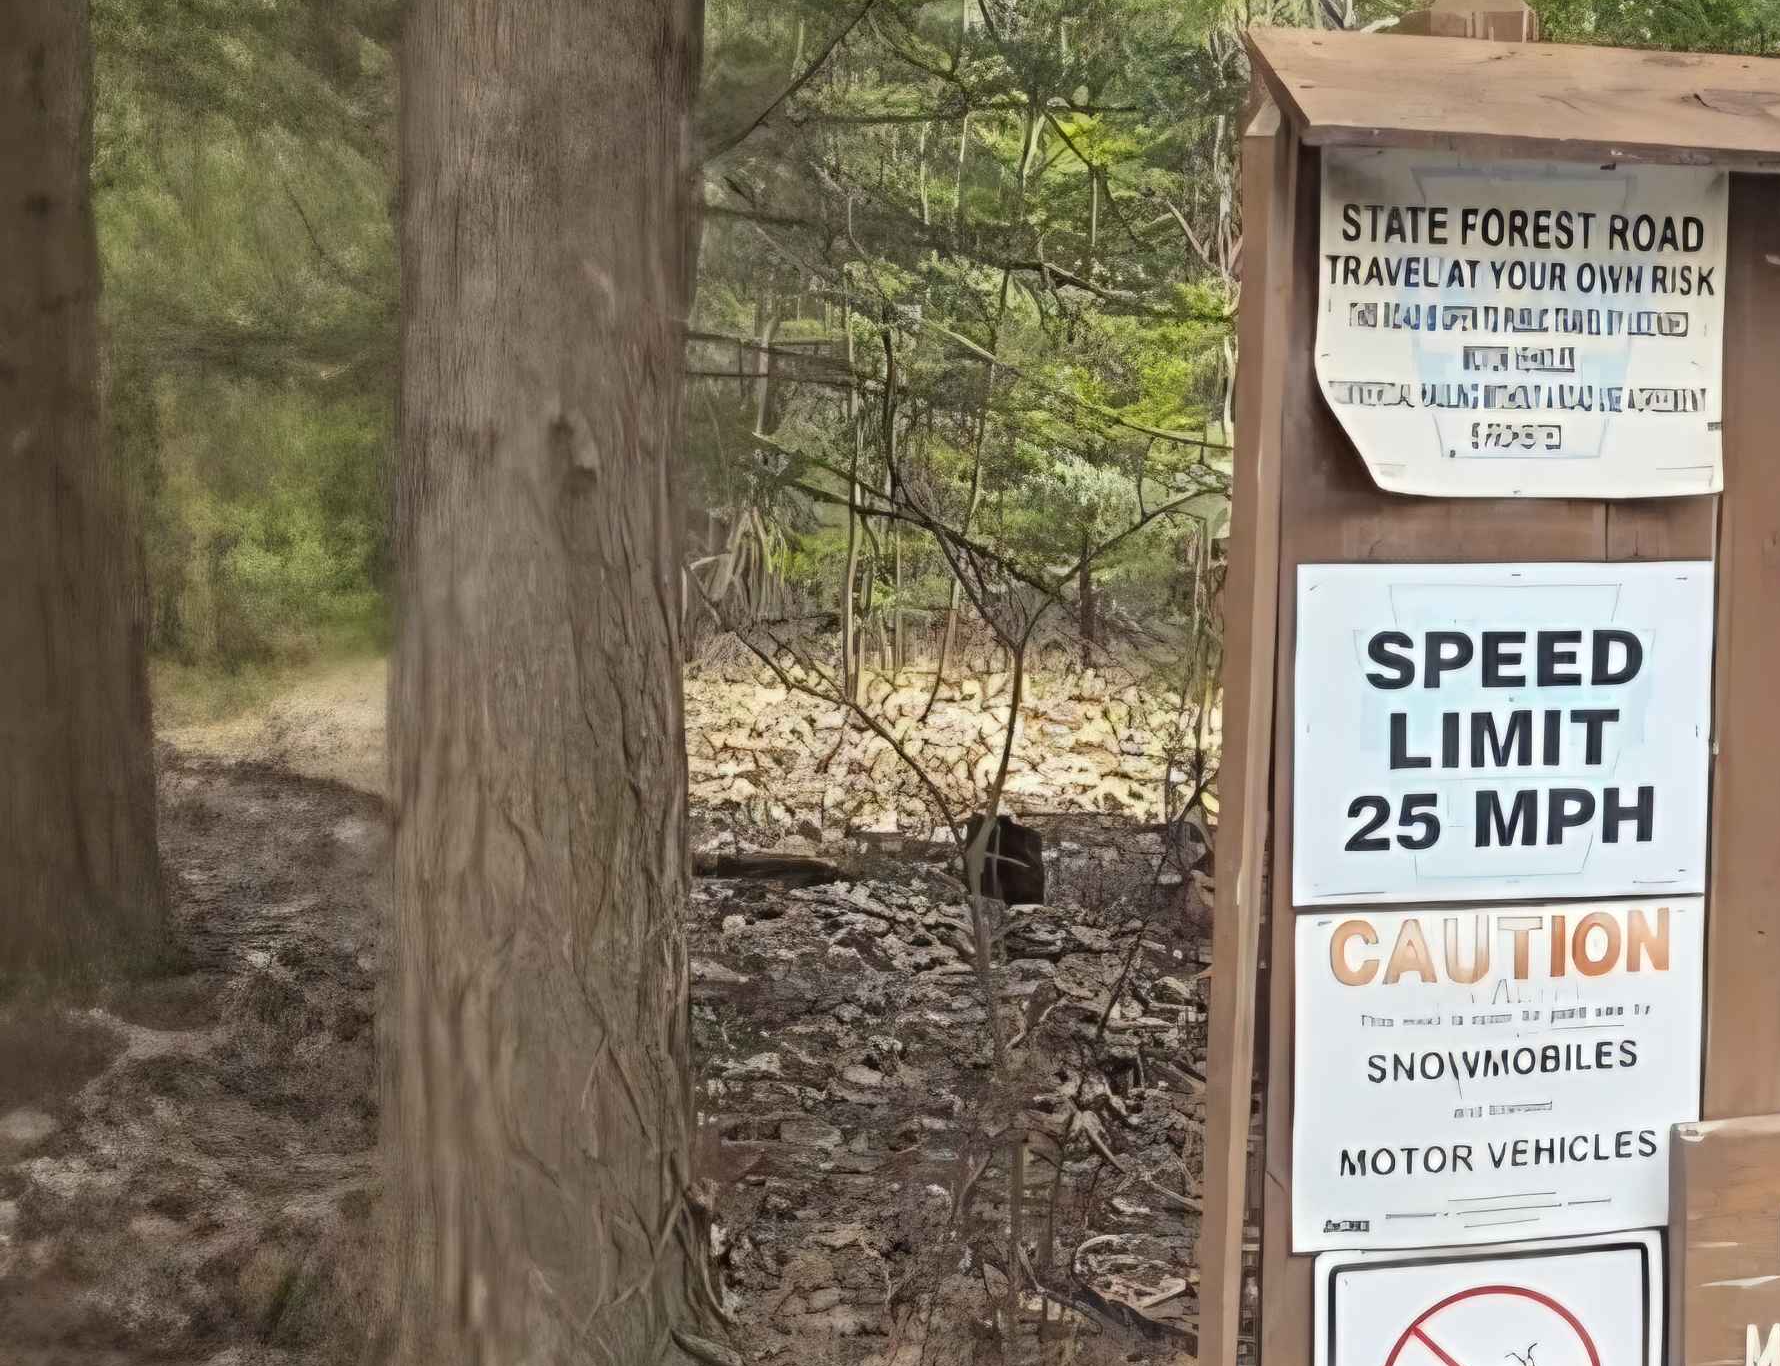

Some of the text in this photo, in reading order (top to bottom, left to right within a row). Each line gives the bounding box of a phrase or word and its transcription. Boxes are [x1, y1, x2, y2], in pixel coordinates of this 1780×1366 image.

[1341, 203, 1704, 253] STATE FOREST ROAD
[1325, 254, 1716, 296] TRAVEL AT YOUR OWN RISK
[1365, 629, 1644, 690] SPEED
[1389, 708, 1620, 770] LIMIT
[1344, 786, 1654, 852] 25 MPH
[1329, 907, 1670, 987] CAUTION
[1367, 1039, 1639, 1084] SNOWMOBILES
[1340, 1129, 1658, 1177] MOTOR VEHICLES
